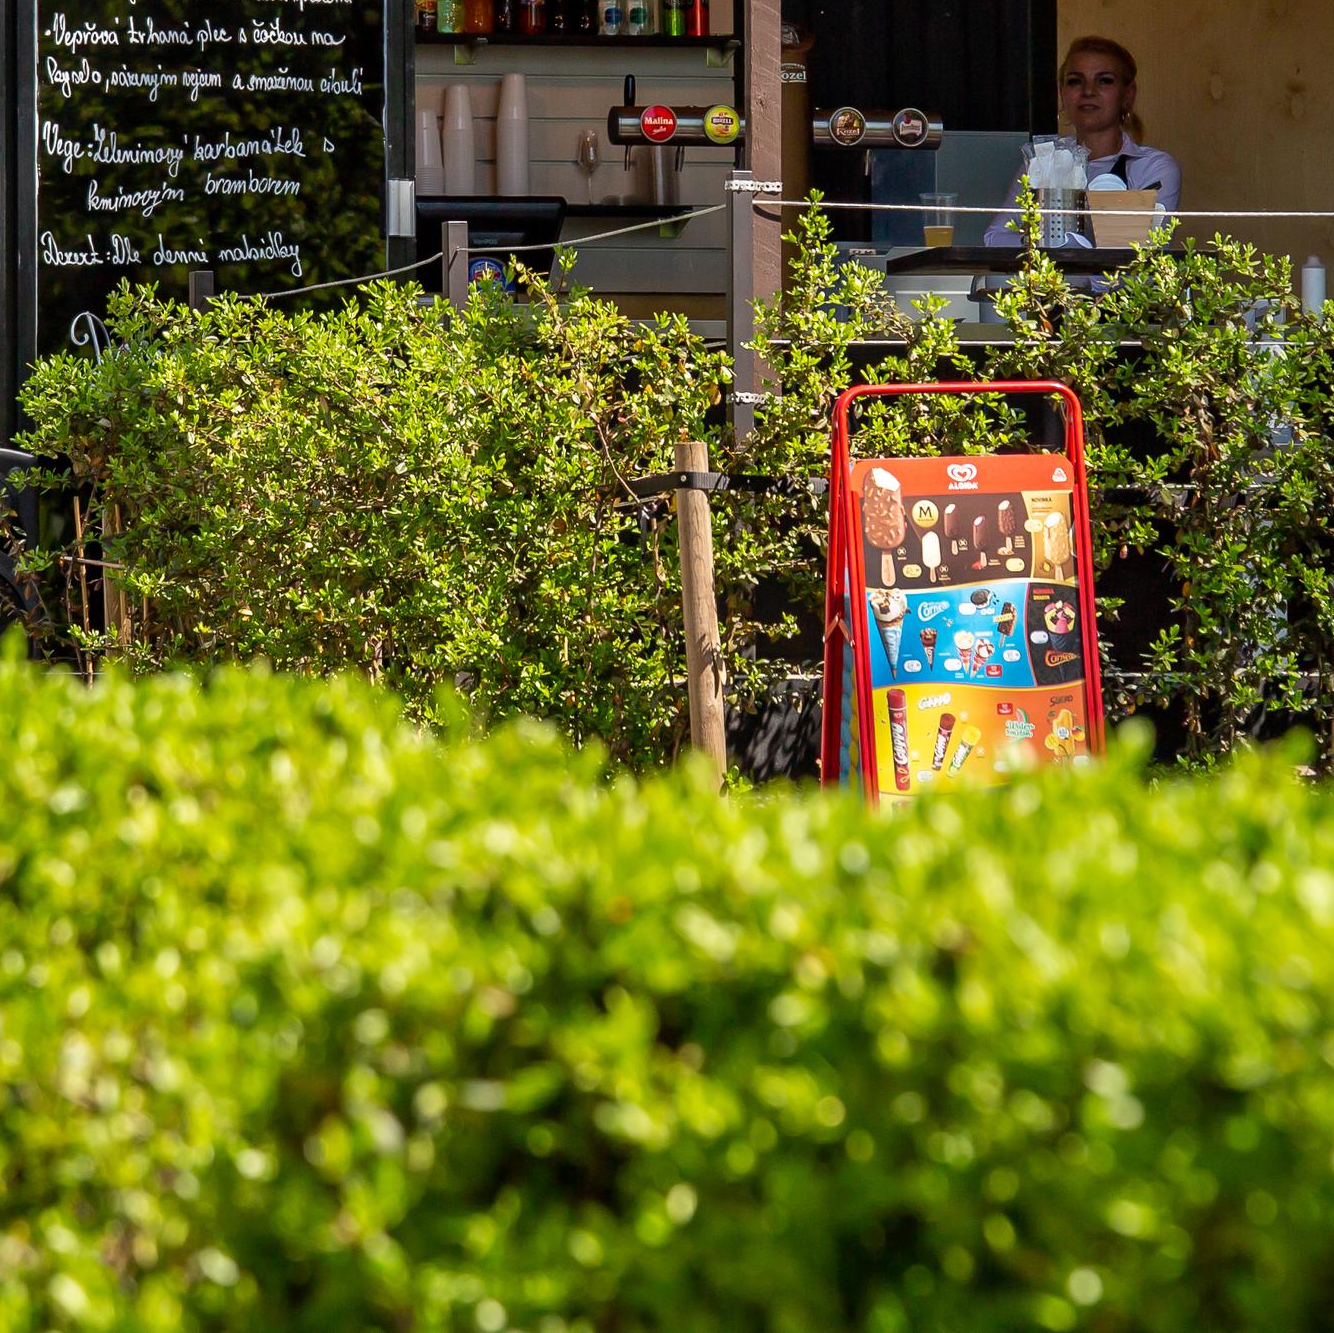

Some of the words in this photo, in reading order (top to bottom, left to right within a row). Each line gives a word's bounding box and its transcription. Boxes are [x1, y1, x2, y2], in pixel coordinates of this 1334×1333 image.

[310, 30, 346, 46] na
[231, 75, 245, 90] a
[205, 169, 301, 196] bramborem
